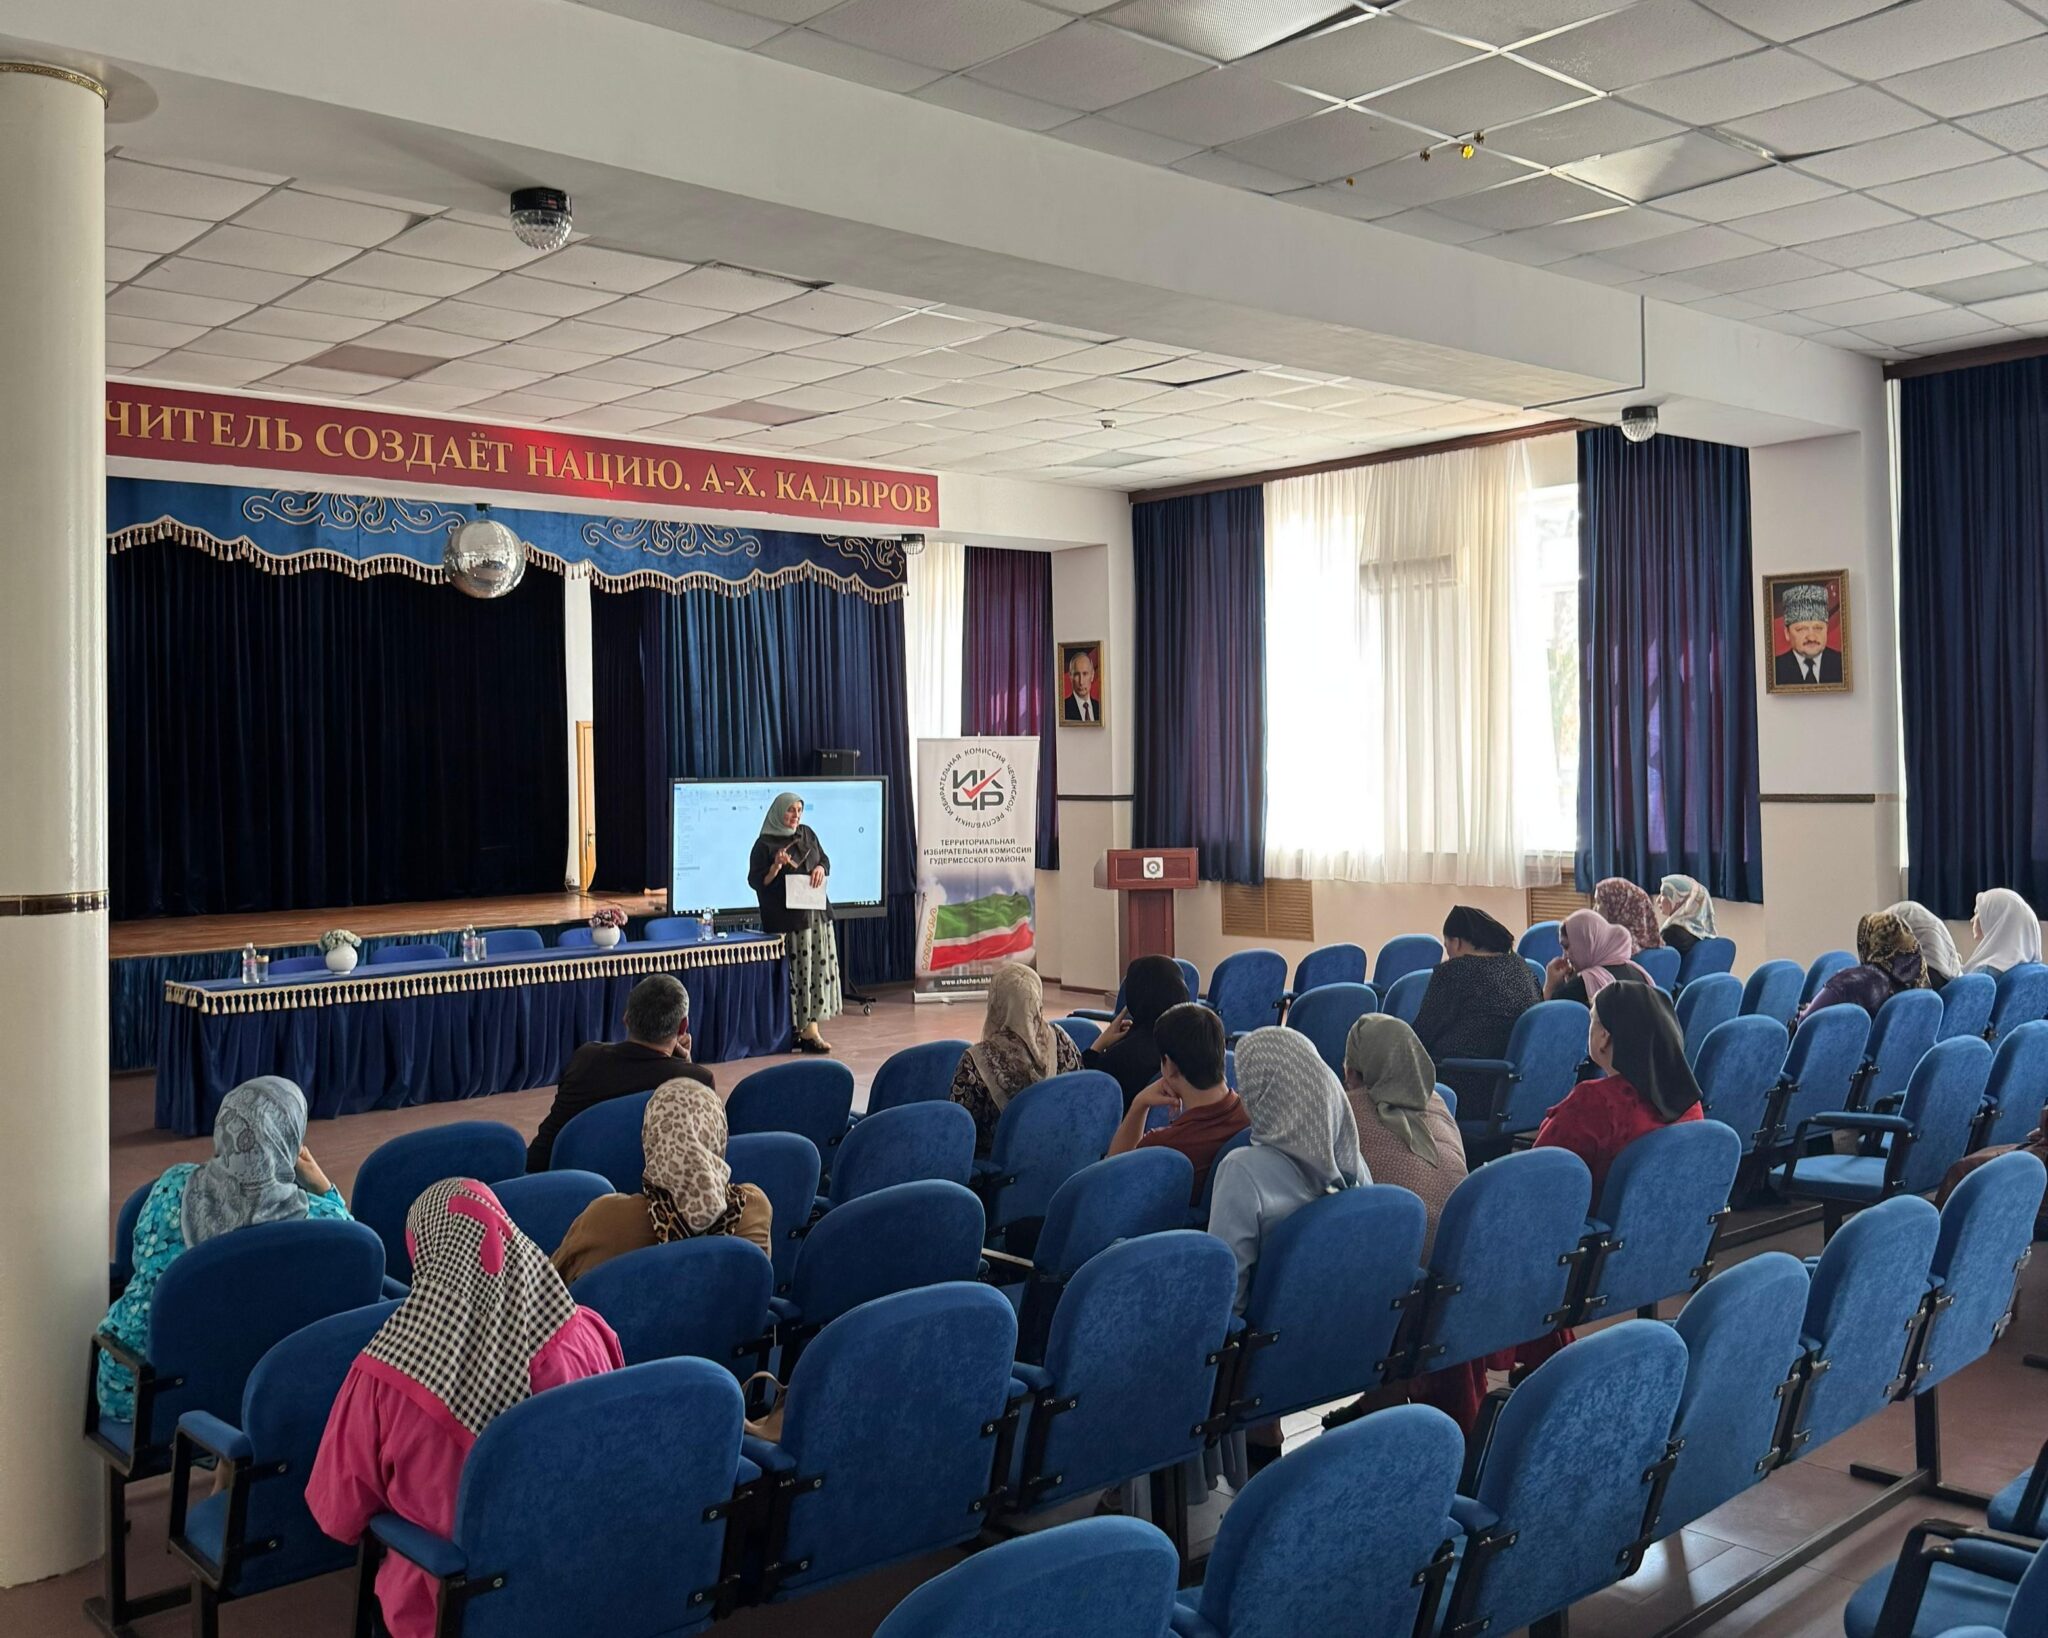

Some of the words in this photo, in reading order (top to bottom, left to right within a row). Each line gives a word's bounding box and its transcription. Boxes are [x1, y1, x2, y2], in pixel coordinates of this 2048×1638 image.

[316, 422, 513, 475] СОЗДАЁТ
[527, 444, 691, 494] НАЦИЮ.
[700, 463, 766, 498] А-Х.
[776, 471, 932, 514] КАДЫРОВ
[964, 747, 1006, 764] КОМИССИЯ
[939, 753, 962, 816] ИЗБИРАТЕЛЬНАЯ
[1005, 764, 1017, 812] ЧЕЧЕНСКОЙ
[955, 812, 1005, 829] РЕСПУБЛИКИ
[940, 838, 1016, 846] ТЕРРИТОРИАЛЬНАЯ
[923, 847, 988, 856] ИЗБИРАТЕЛЬНАЯ
[989, 846, 1032, 854] КОМИССИЯ
[929, 856, 994, 866] ГУДЕРМЕССКОГО
[995, 855, 1026, 863] РАЙОНА
